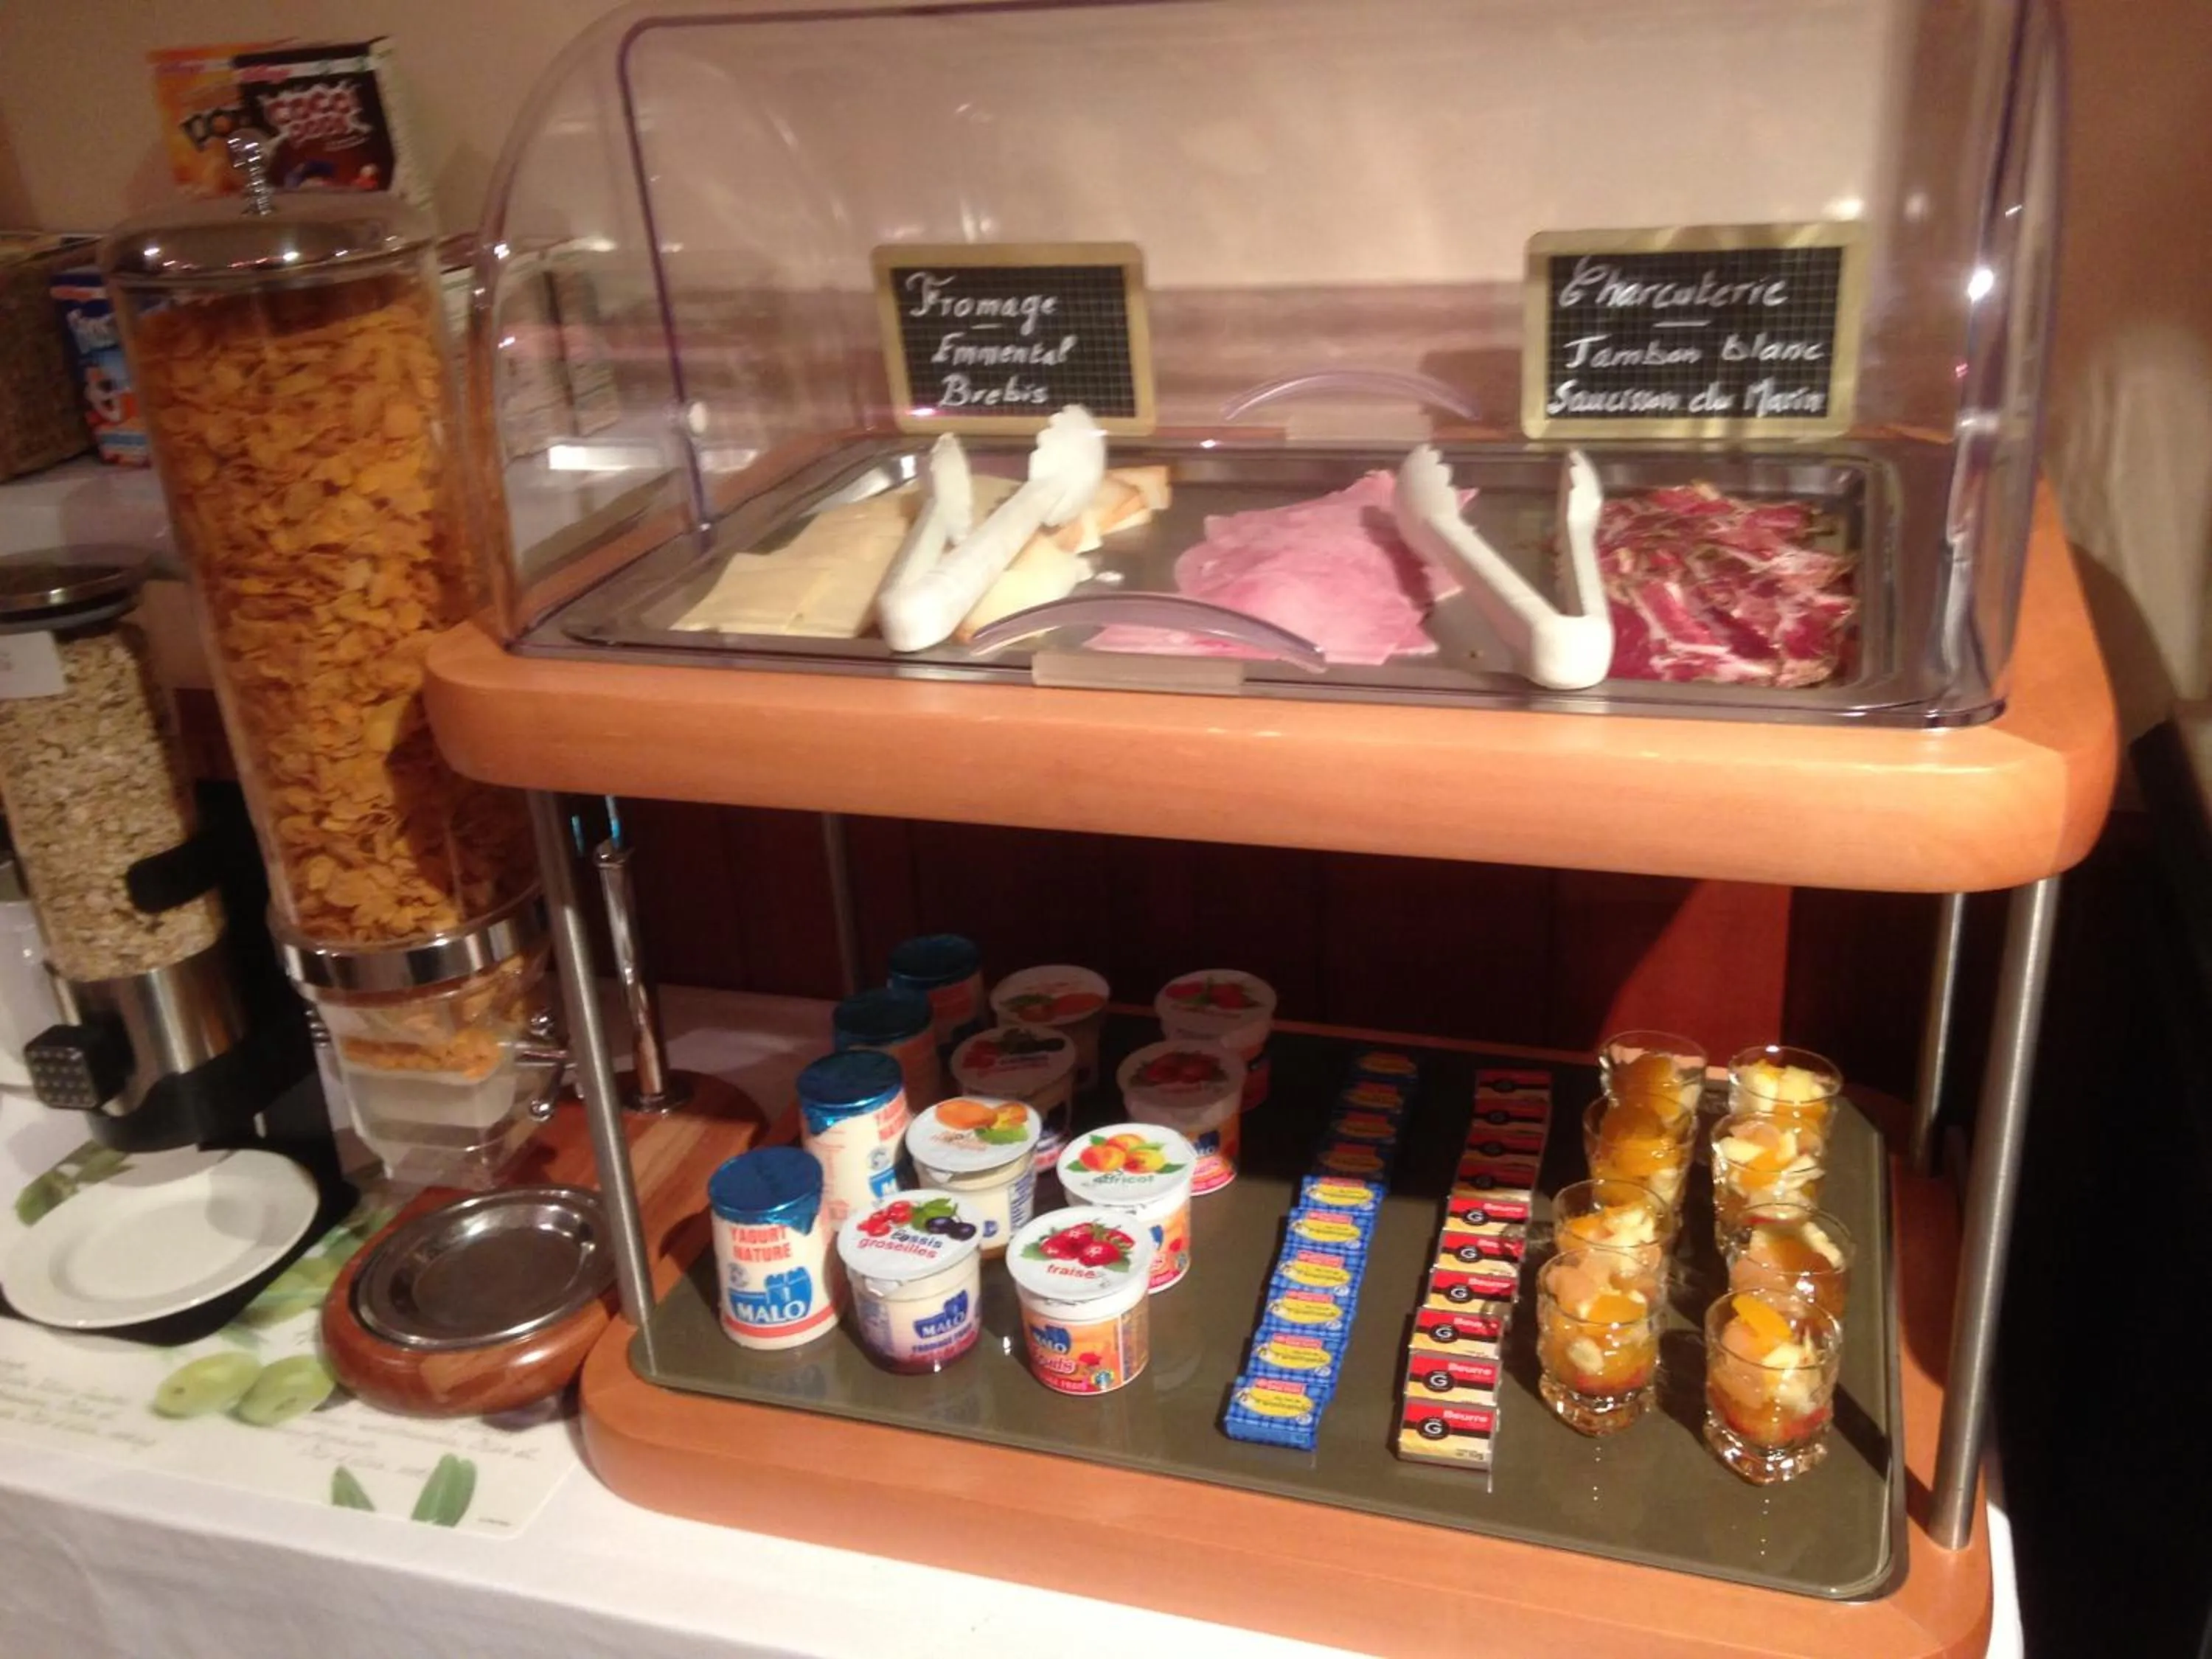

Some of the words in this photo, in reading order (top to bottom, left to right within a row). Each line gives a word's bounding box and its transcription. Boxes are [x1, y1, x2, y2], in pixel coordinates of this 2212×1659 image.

[905, 271, 1059, 336] Fromage
[931, 332, 1079, 366] Emmental
[1562, 334, 1703, 369] Jambon
[938, 372, 1049, 407] Brebis
[1547, 378, 1680, 415] Saucisson
[1688, 380, 1736, 413] du
[857, 1237, 939, 1259] groseilles
[1047, 1263, 1096, 1280] fraise
[737, 1299, 807, 1323] MALO
[922, 1309, 967, 1338] MALO
[1447, 1361, 1493, 1377] Beurre
[1429, 1376, 1448, 1388] G
[1423, 1421, 1443, 1434] G
[1442, 1409, 1489, 1424] Beurre
